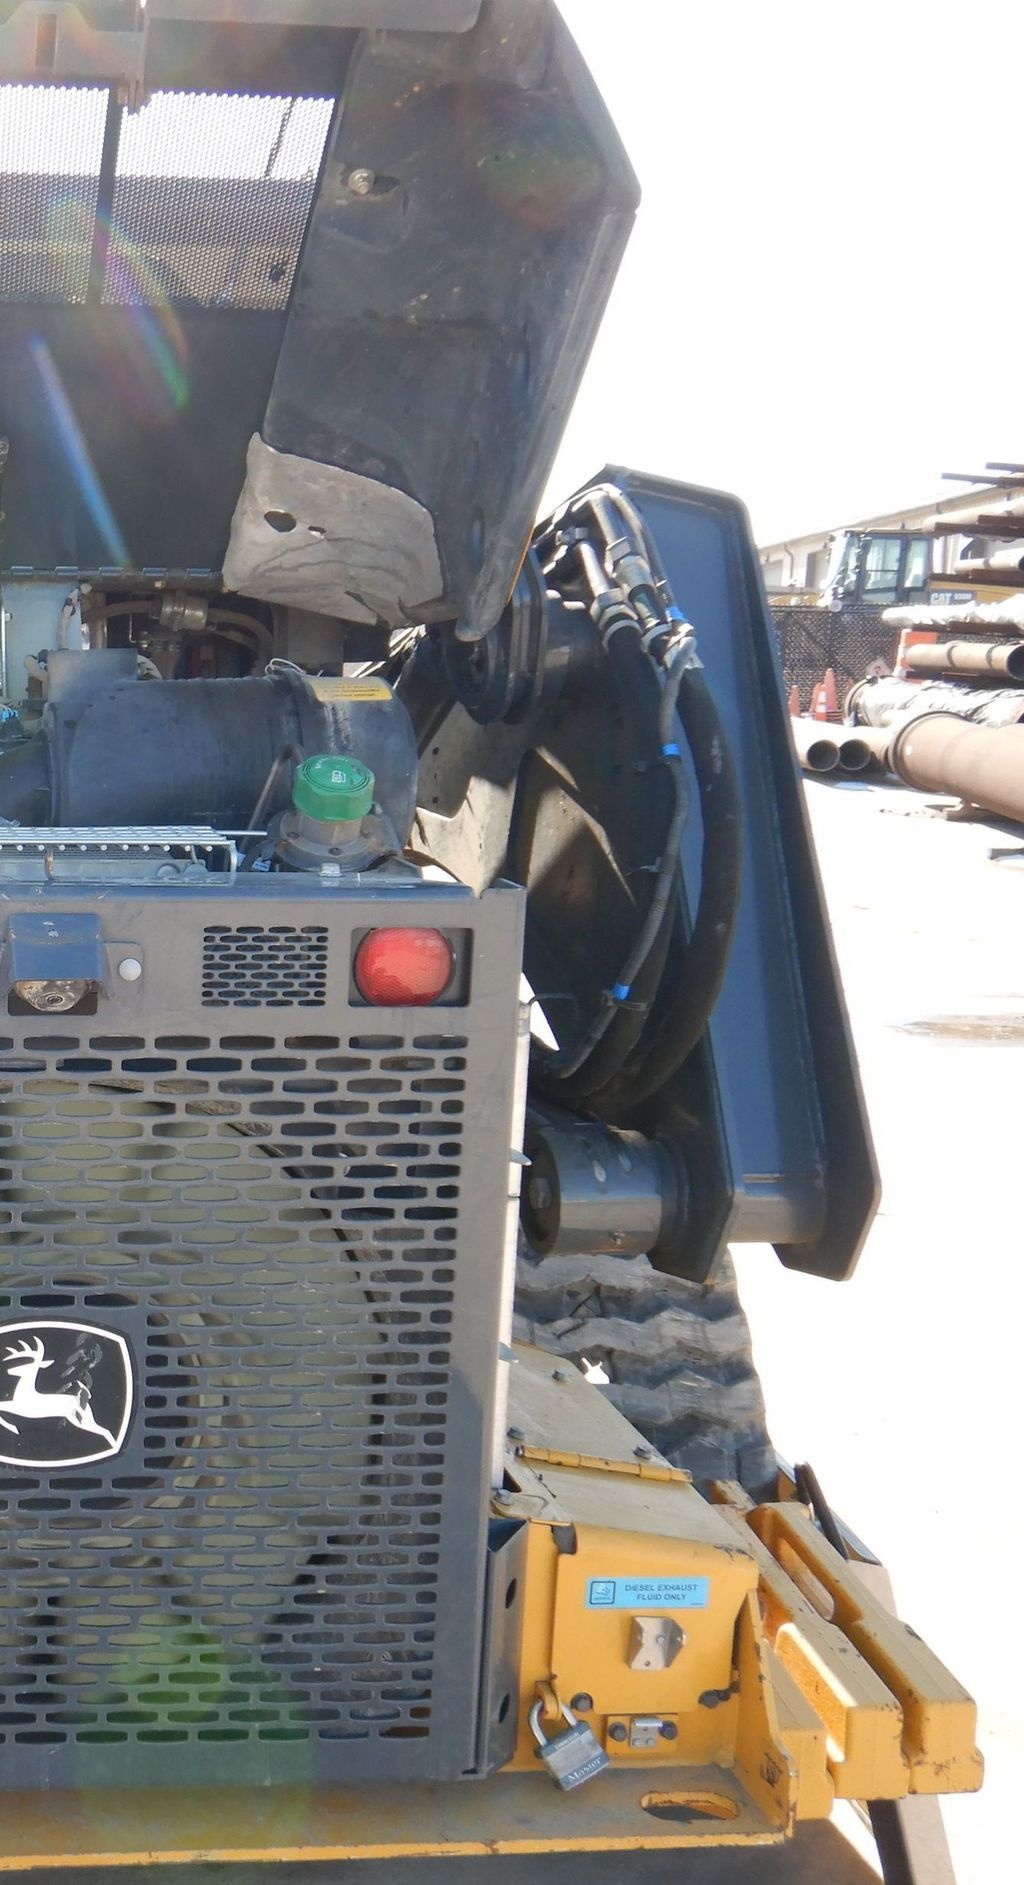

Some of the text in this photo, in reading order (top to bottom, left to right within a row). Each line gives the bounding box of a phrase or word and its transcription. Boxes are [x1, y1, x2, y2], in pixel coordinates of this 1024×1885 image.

[931, 592, 952, 605] CAT
[625, 1584, 698, 1592] DIESEL EXHAUST
[637, 1593, 687, 1601] FLUID ONLY
[567, 1756, 601, 1783] Master
